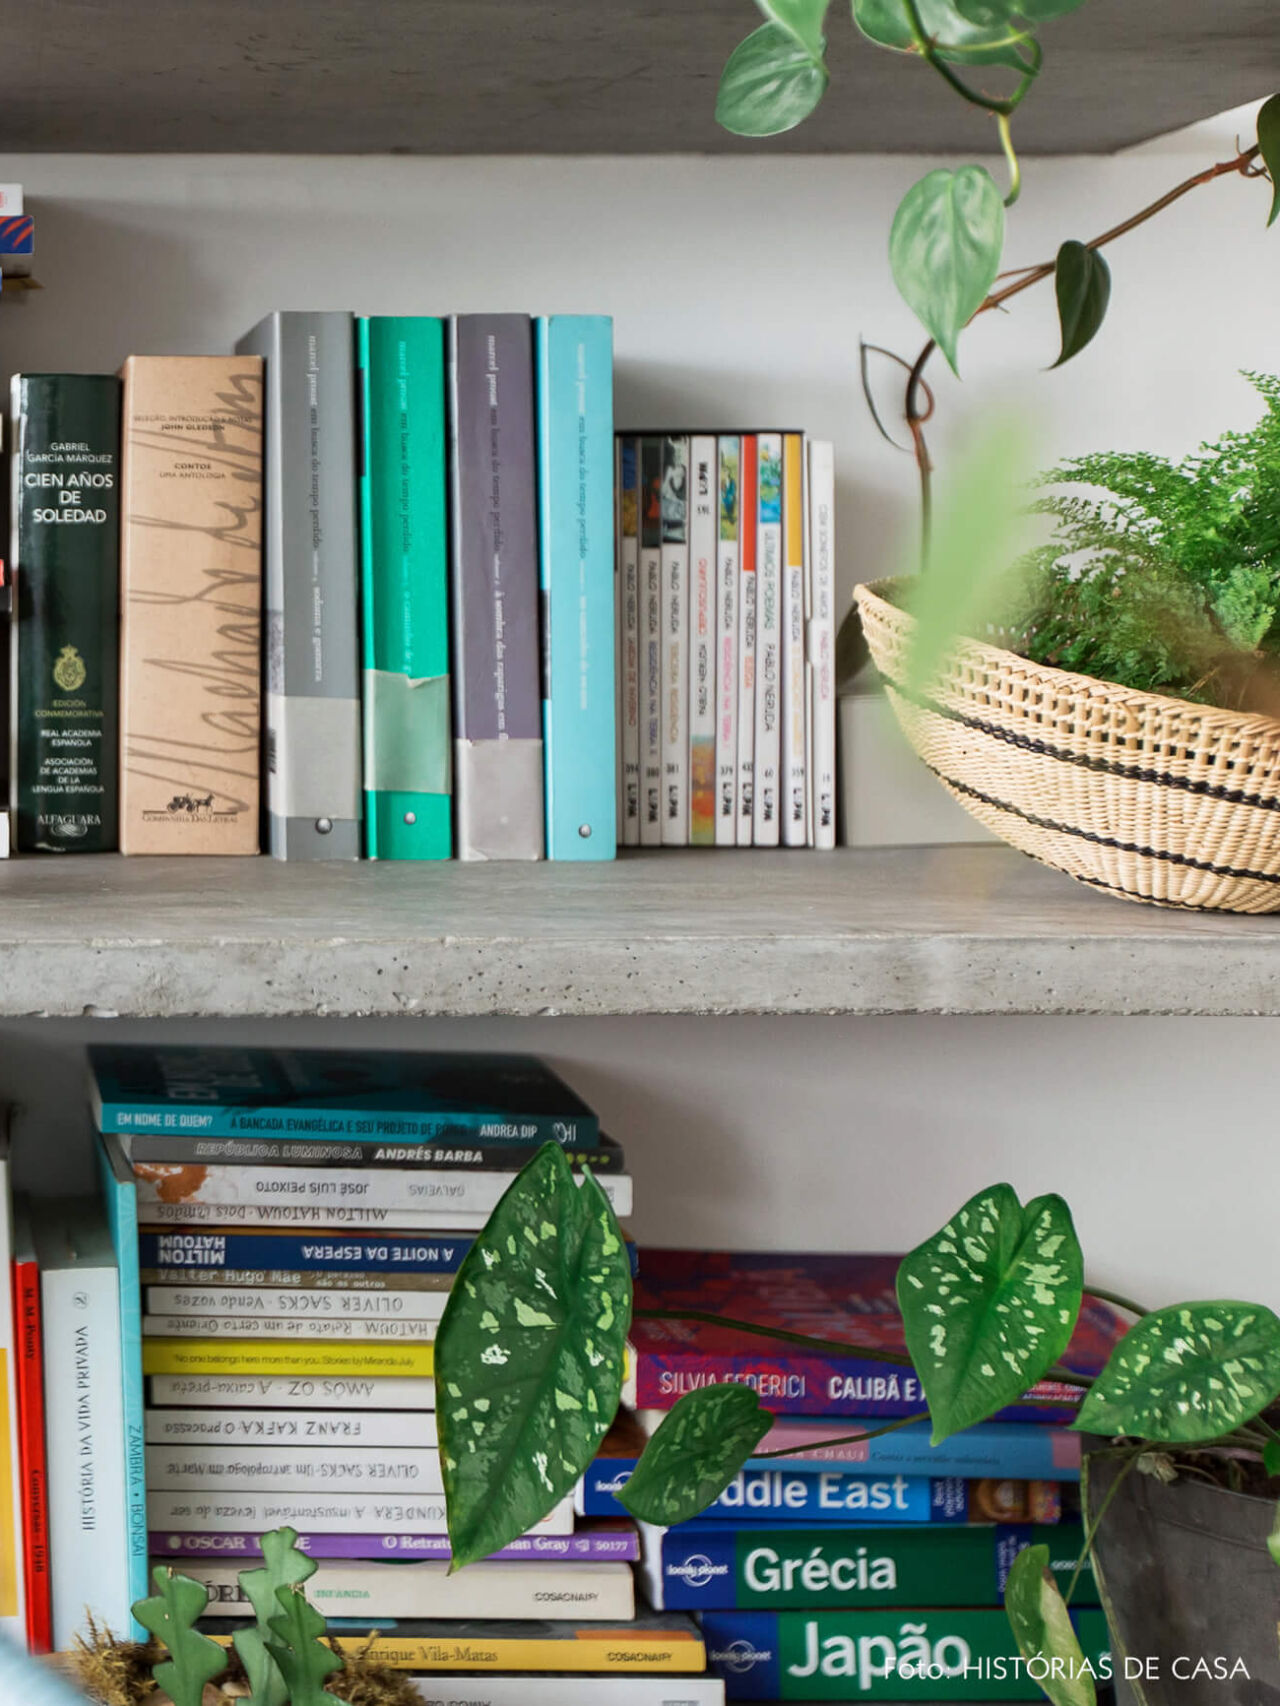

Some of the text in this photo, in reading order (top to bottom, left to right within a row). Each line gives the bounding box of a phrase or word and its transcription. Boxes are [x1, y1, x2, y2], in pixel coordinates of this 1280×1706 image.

[50, 442, 91, 452] GABRIEL
[27, 452, 113, 465] GARCÍA MÁRQUEZ
[25, 468, 114, 488] CIEN AÑOS
[59, 490, 82, 505] DE
[33, 508, 106, 524] SOLEDAD
[38, 814, 101, 826] ALFAGUARA
[117, 1112, 538, 1139] EM NOME DE QUEM? ANDREA DIP
[375, 1146, 483, 1163] ANDRÉS BARBA
[302, 1246, 454, 1262] A NOITE DA ESPERA
[830, 1372, 900, 1400] CALIBÃ
[74, 1326, 96, 1530] HISTÓRIA DA VIDA PRIVADA
[240, 1420, 361, 1436] FRANZ KAFKA
[128, 1424, 145, 1557] ZAMBRA BONSAI
[819, 1474, 908, 1509] East
[186, 1536, 570, 1554] OSCAR Gray
[744, 1546, 896, 1592] Grécia
[788, 1621, 972, 1690] Japão
